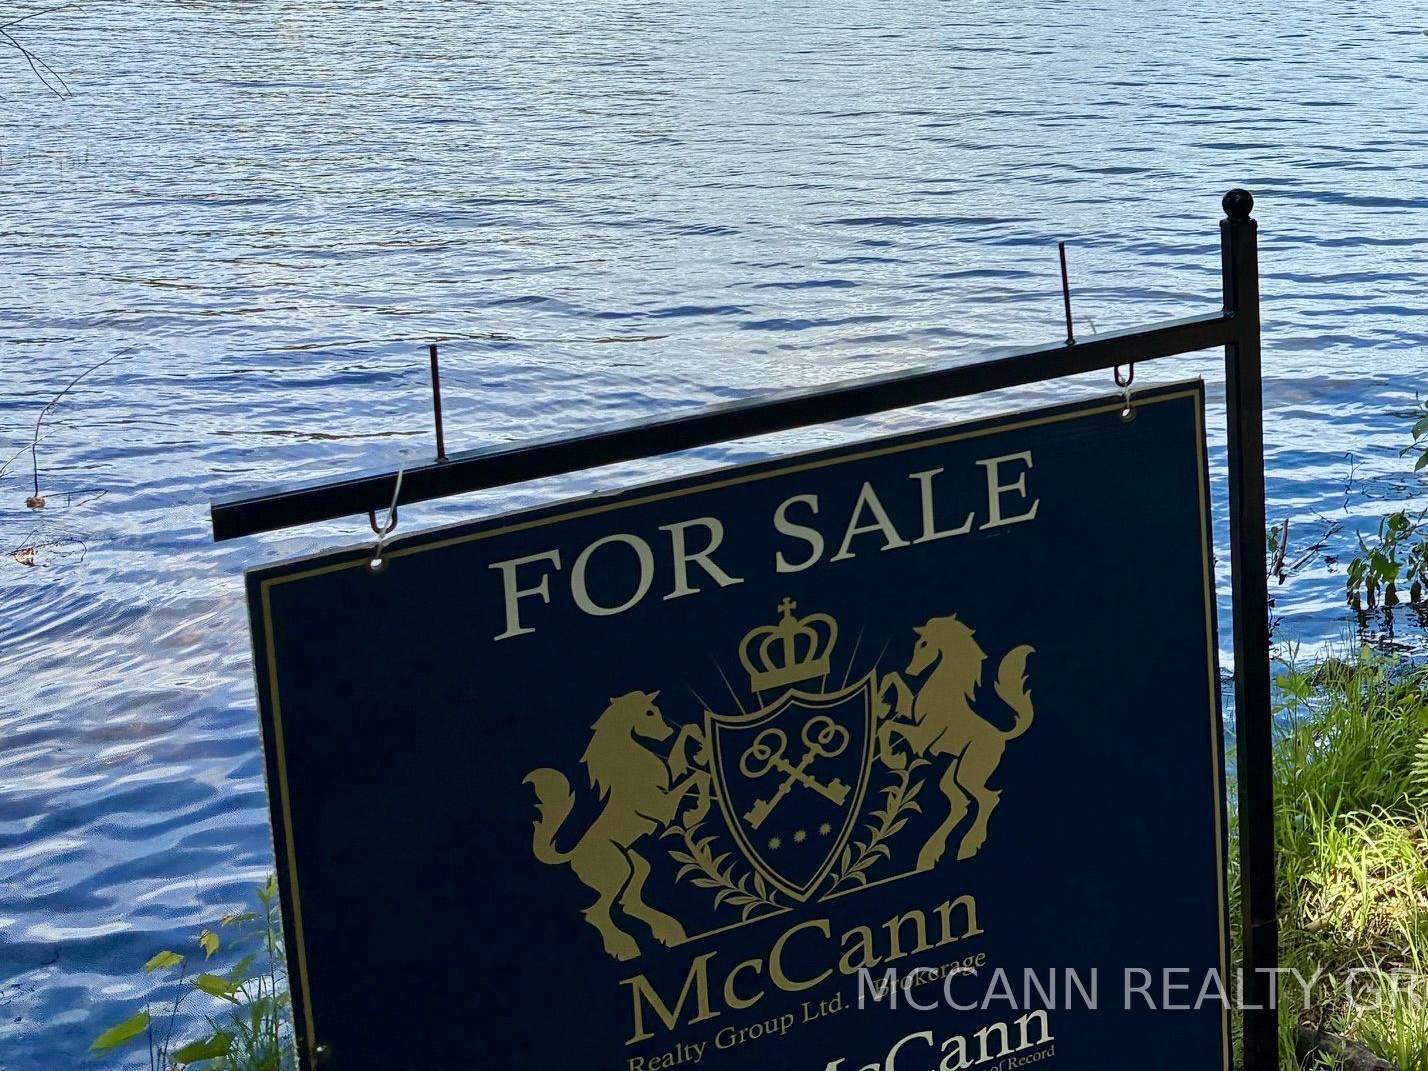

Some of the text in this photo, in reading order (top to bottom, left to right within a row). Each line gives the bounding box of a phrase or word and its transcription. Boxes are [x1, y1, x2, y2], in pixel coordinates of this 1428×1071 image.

[487, 449, 1041, 641] FOR SALE
[618, 893, 985, 1047] McCann
[626, 1041, 708, 1071] Realty
[714, 1012, 795, 1050] Group
[801, 991, 850, 1024] Ltd.
[872, 951, 987, 999] Brokerage
[824, 1008, 1055, 1071] Cann
[1007, 1044, 1056, 1070] Record
